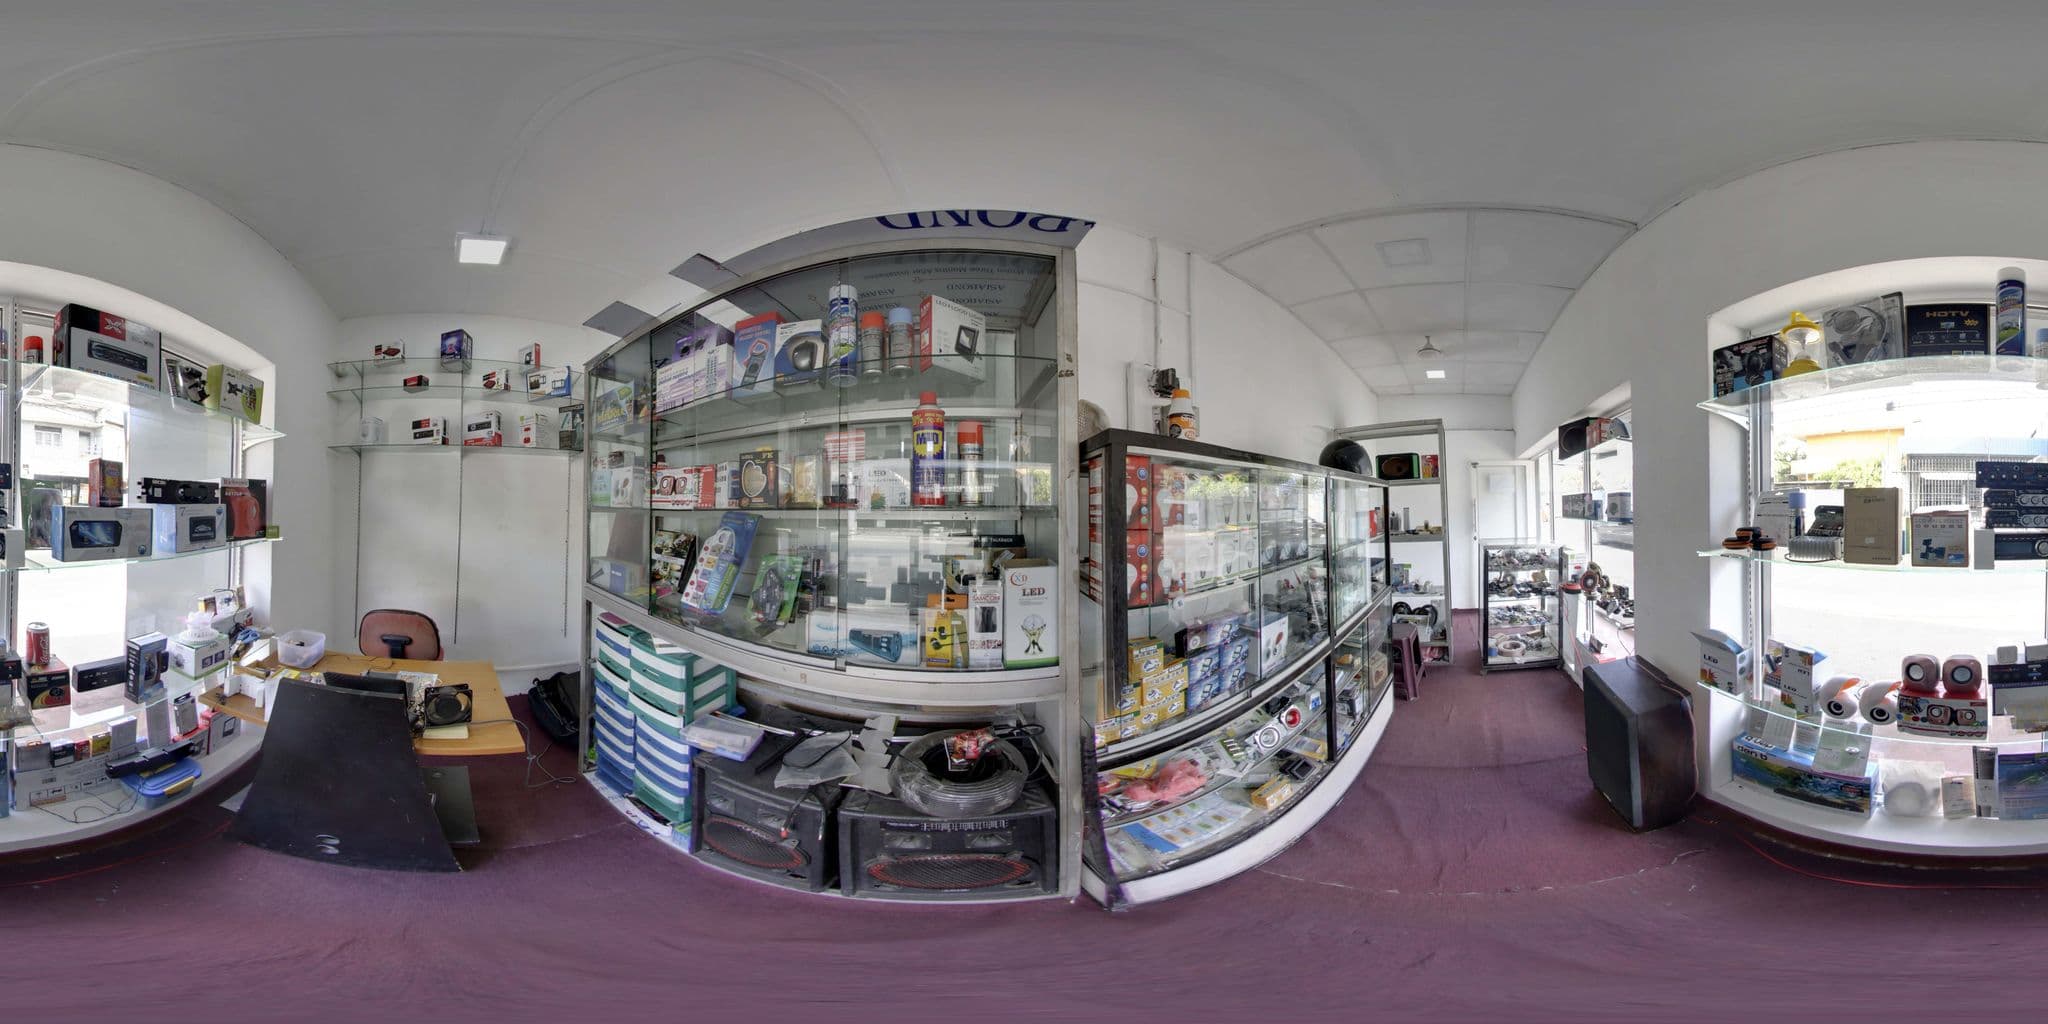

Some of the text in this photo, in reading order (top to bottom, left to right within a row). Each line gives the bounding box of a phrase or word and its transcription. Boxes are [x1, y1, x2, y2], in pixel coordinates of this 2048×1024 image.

[946, 283, 1006, 292] ASIABOND
[1925, 310, 1970, 318] HDTV
[1021, 587, 1046, 597] LED
[1703, 653, 1719, 664] LED
[1783, 684, 1797, 693] LED
